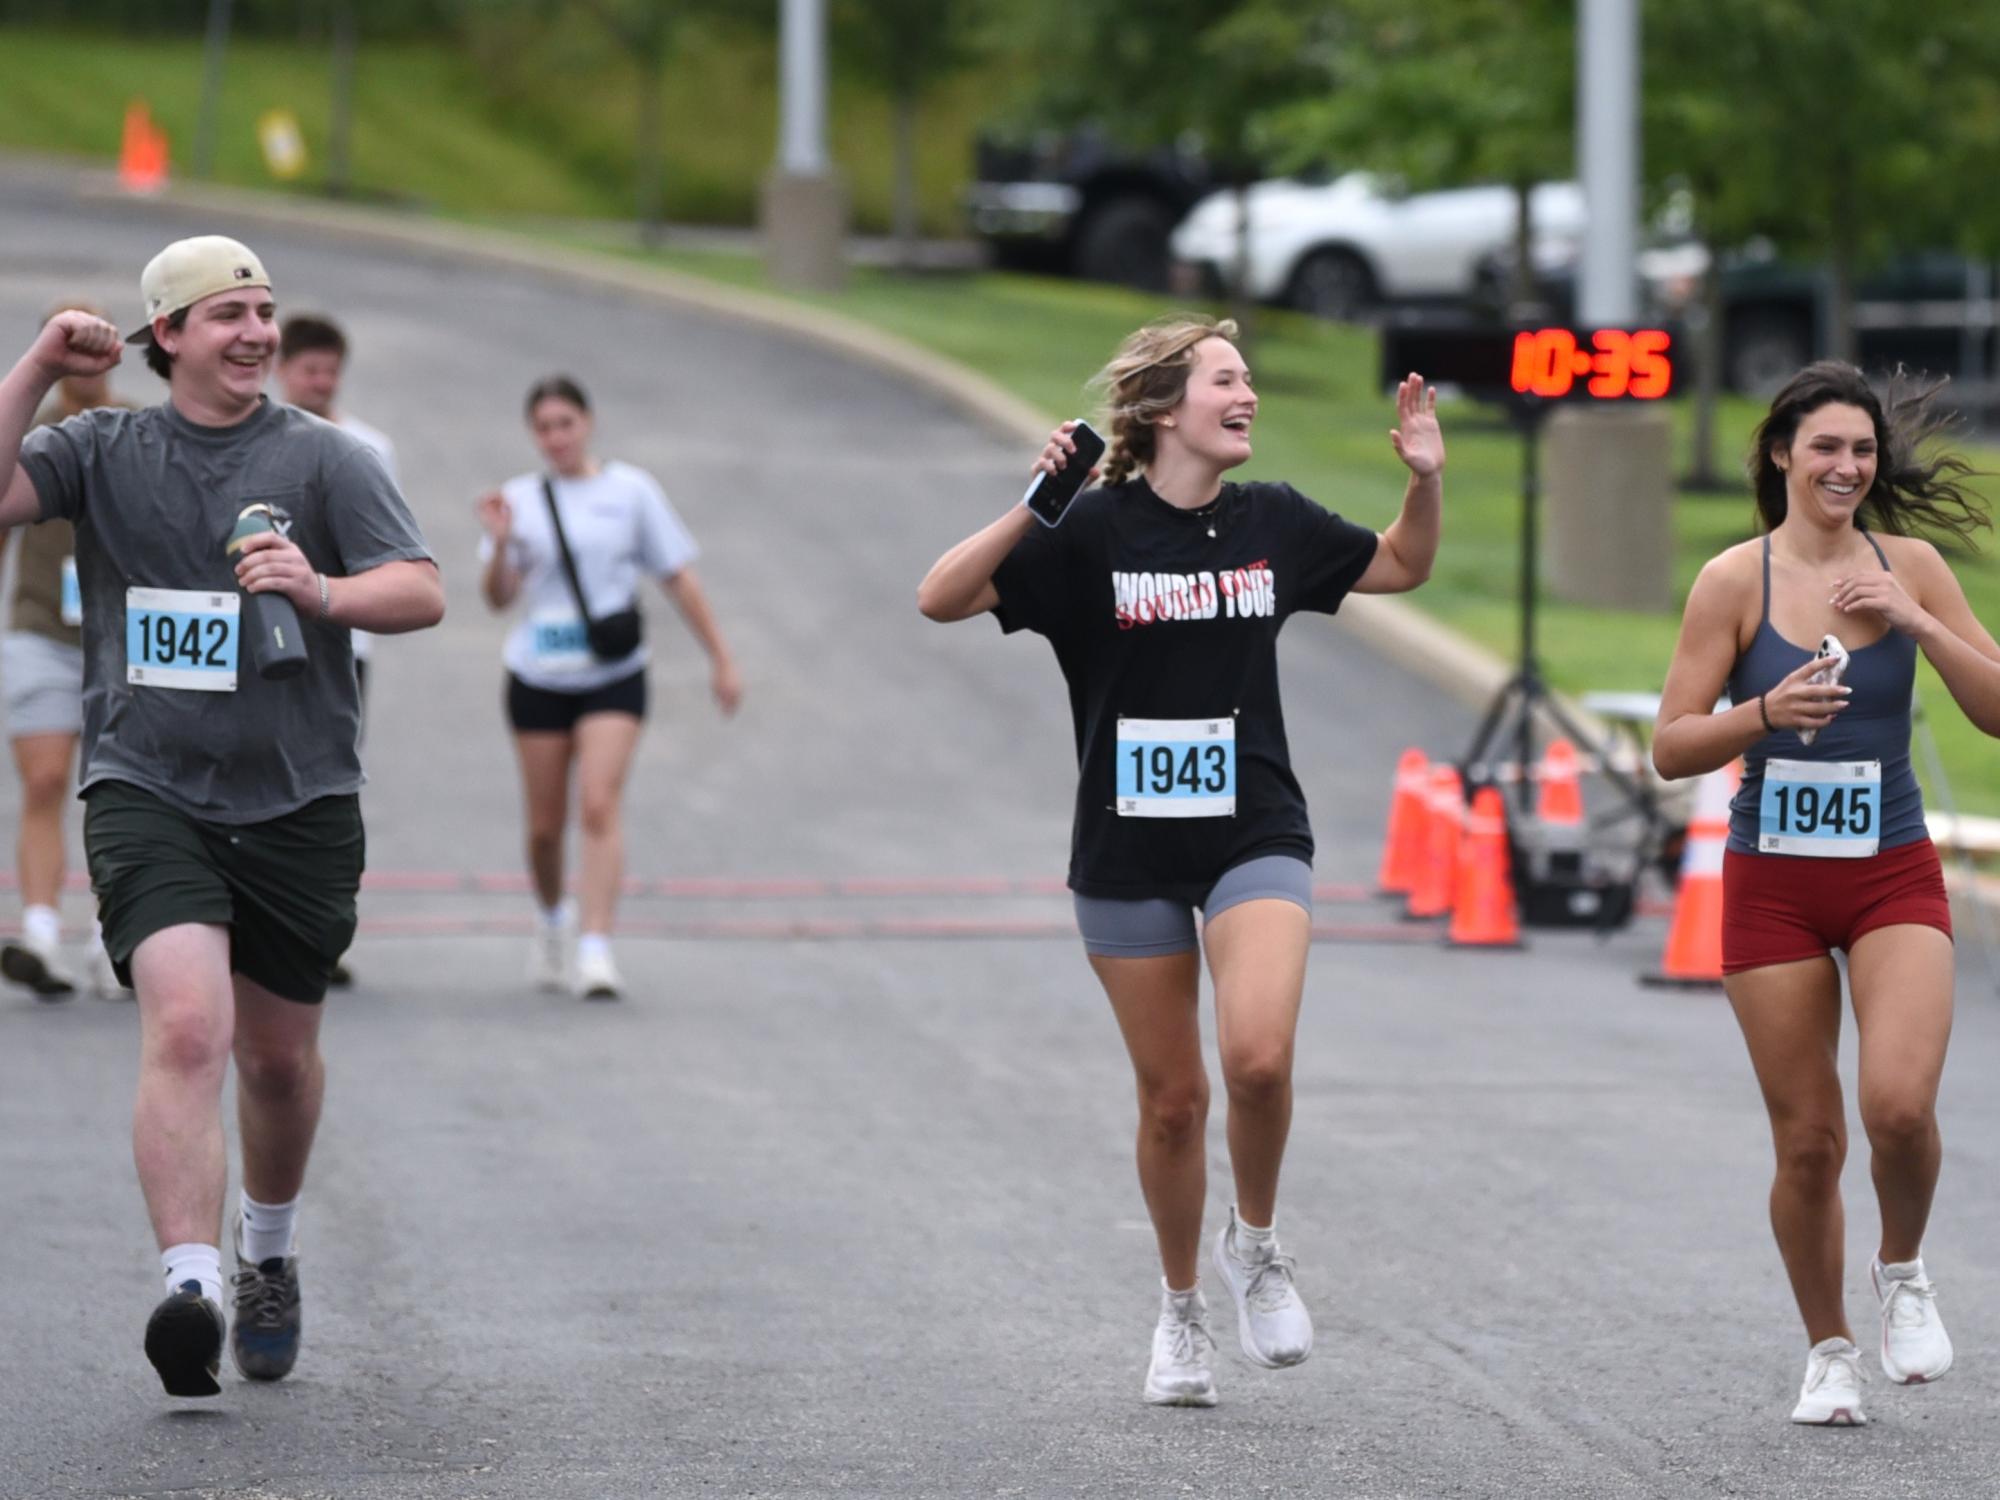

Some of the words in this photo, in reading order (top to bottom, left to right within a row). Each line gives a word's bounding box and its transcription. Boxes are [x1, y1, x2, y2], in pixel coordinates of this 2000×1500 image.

[1511, 328, 1671, 398] 10:35
[1219, 569, 1276, 618] TOUR
[138, 615, 229, 667] 1942
[1130, 745, 1227, 794] 1943
[1775, 786, 1872, 835] 1945
